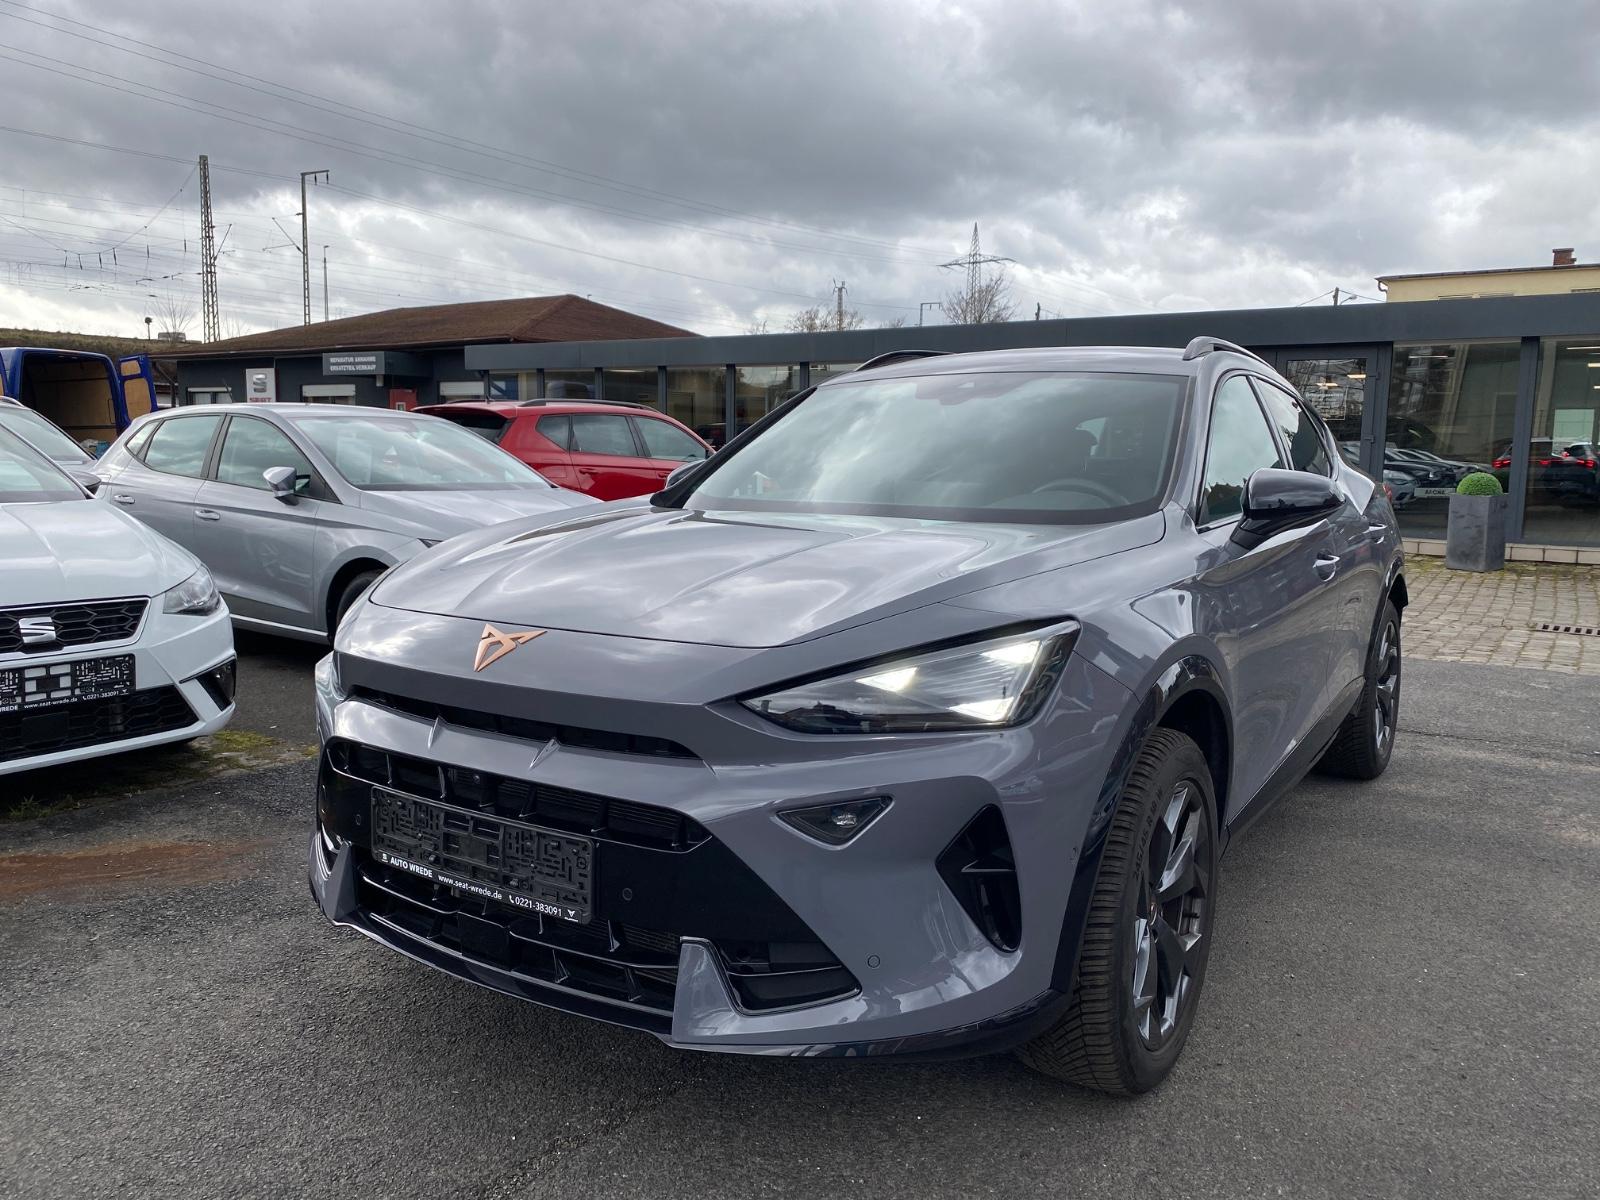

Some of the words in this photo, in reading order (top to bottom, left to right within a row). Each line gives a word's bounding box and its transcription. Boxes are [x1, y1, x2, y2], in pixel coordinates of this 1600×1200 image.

[390, 856, 409, 869] AUTO
[409, 863, 433, 878] WREDE
[438, 874, 502, 900] www.seat-wrede.de
[514, 896, 562, 917] 0221-383091
